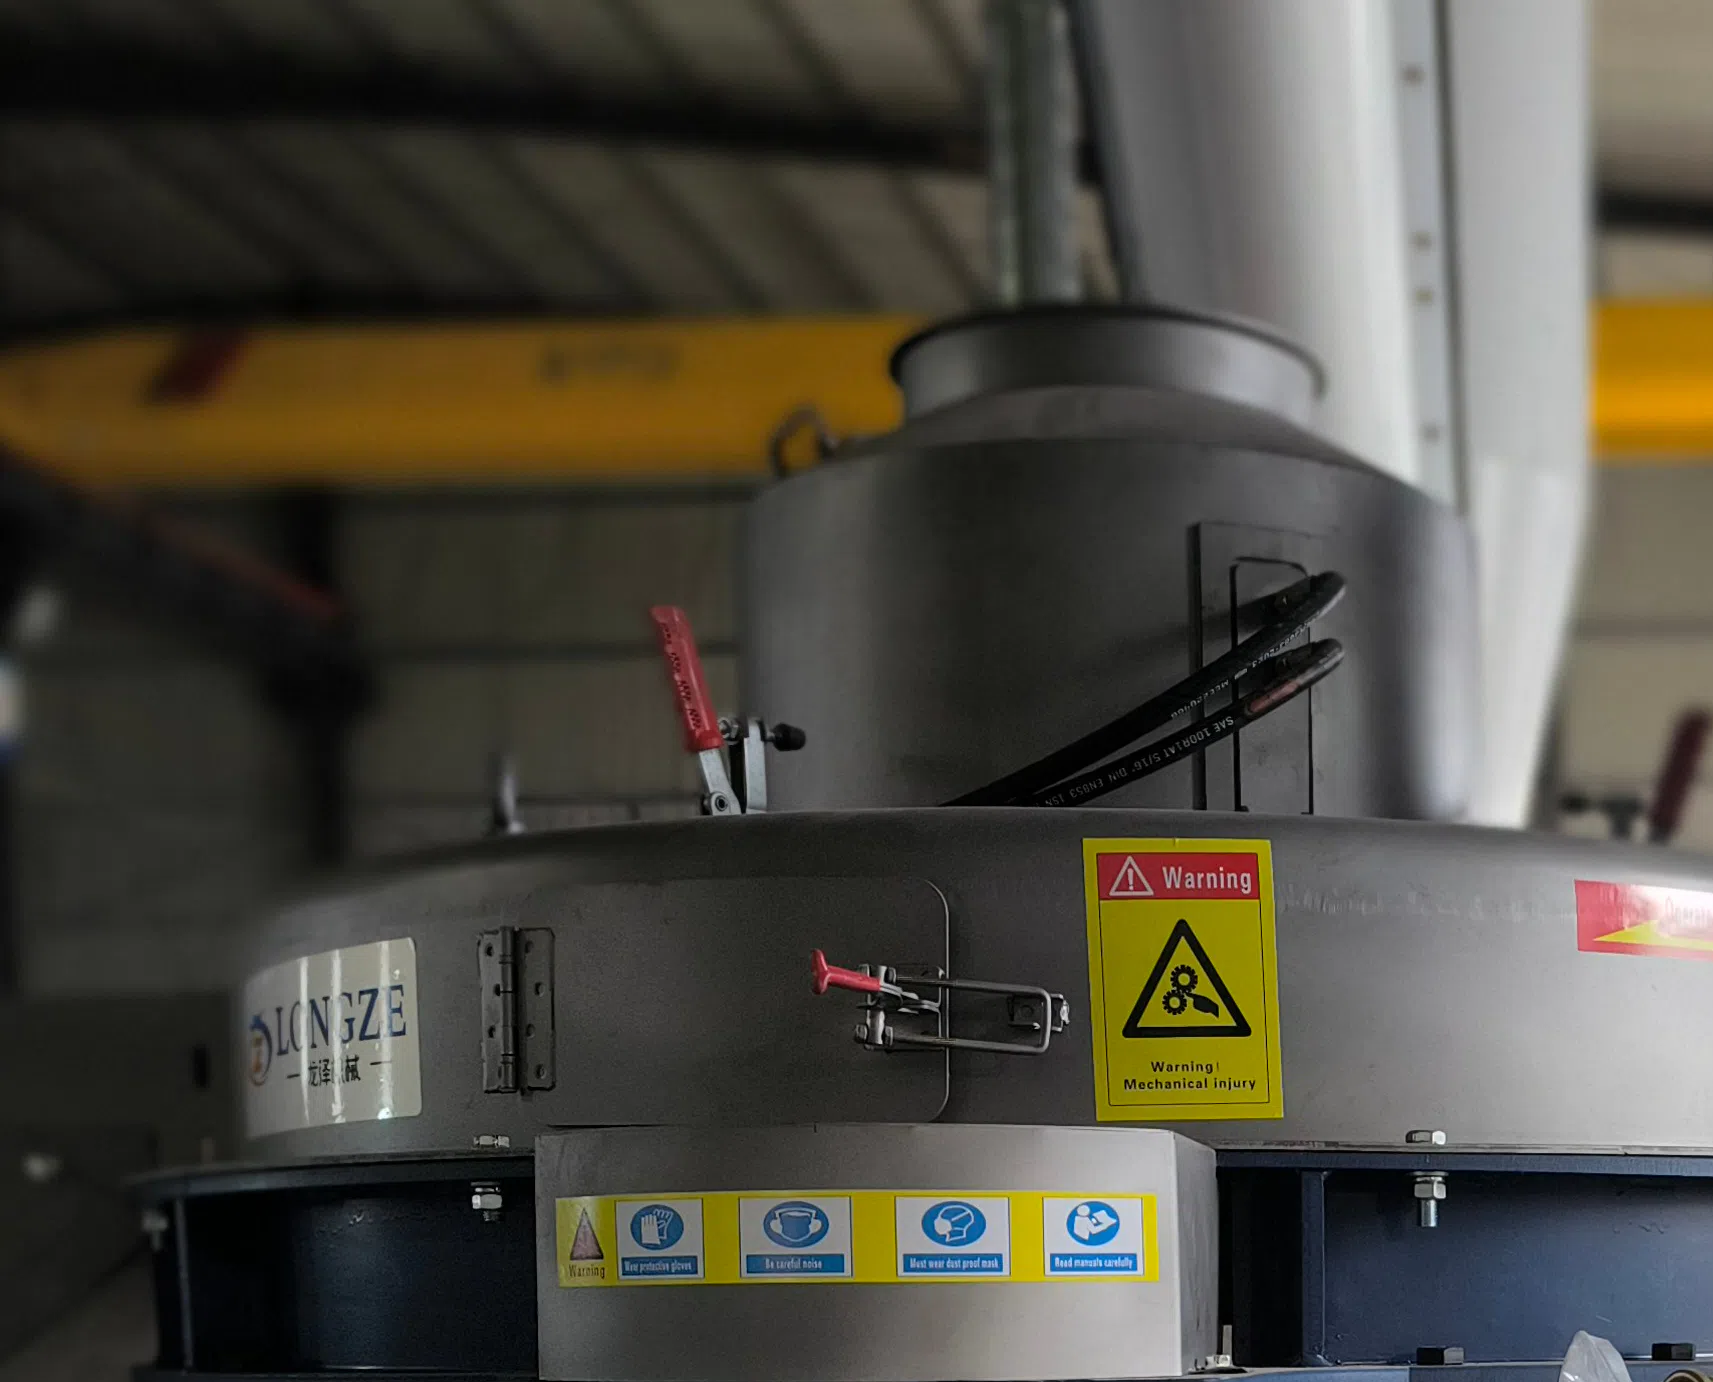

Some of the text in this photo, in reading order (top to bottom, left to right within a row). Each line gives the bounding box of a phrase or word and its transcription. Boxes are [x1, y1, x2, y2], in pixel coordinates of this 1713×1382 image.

[1212, 715, 1234, 733] SAE
[1162, 727, 1211, 759] 100R1AT
[1107, 766, 1129, 782] DIN
[1068, 776, 1104, 799] EN853
[1162, 866, 1251, 895] Warning
[275, 984, 407, 1057] LONGZE
[1124, 1077, 1256, 1091] Mechanical injury
[670, 1261, 692, 1273] gloves
[765, 1258, 823, 1269] Be careful noise
[909, 1257, 999, 1270] Must wear dust proof mask
[1054, 1257, 1073, 1268] Read
[1104, 1257, 1133, 1269] carefully
[568, 1264, 606, 1279] Warning
